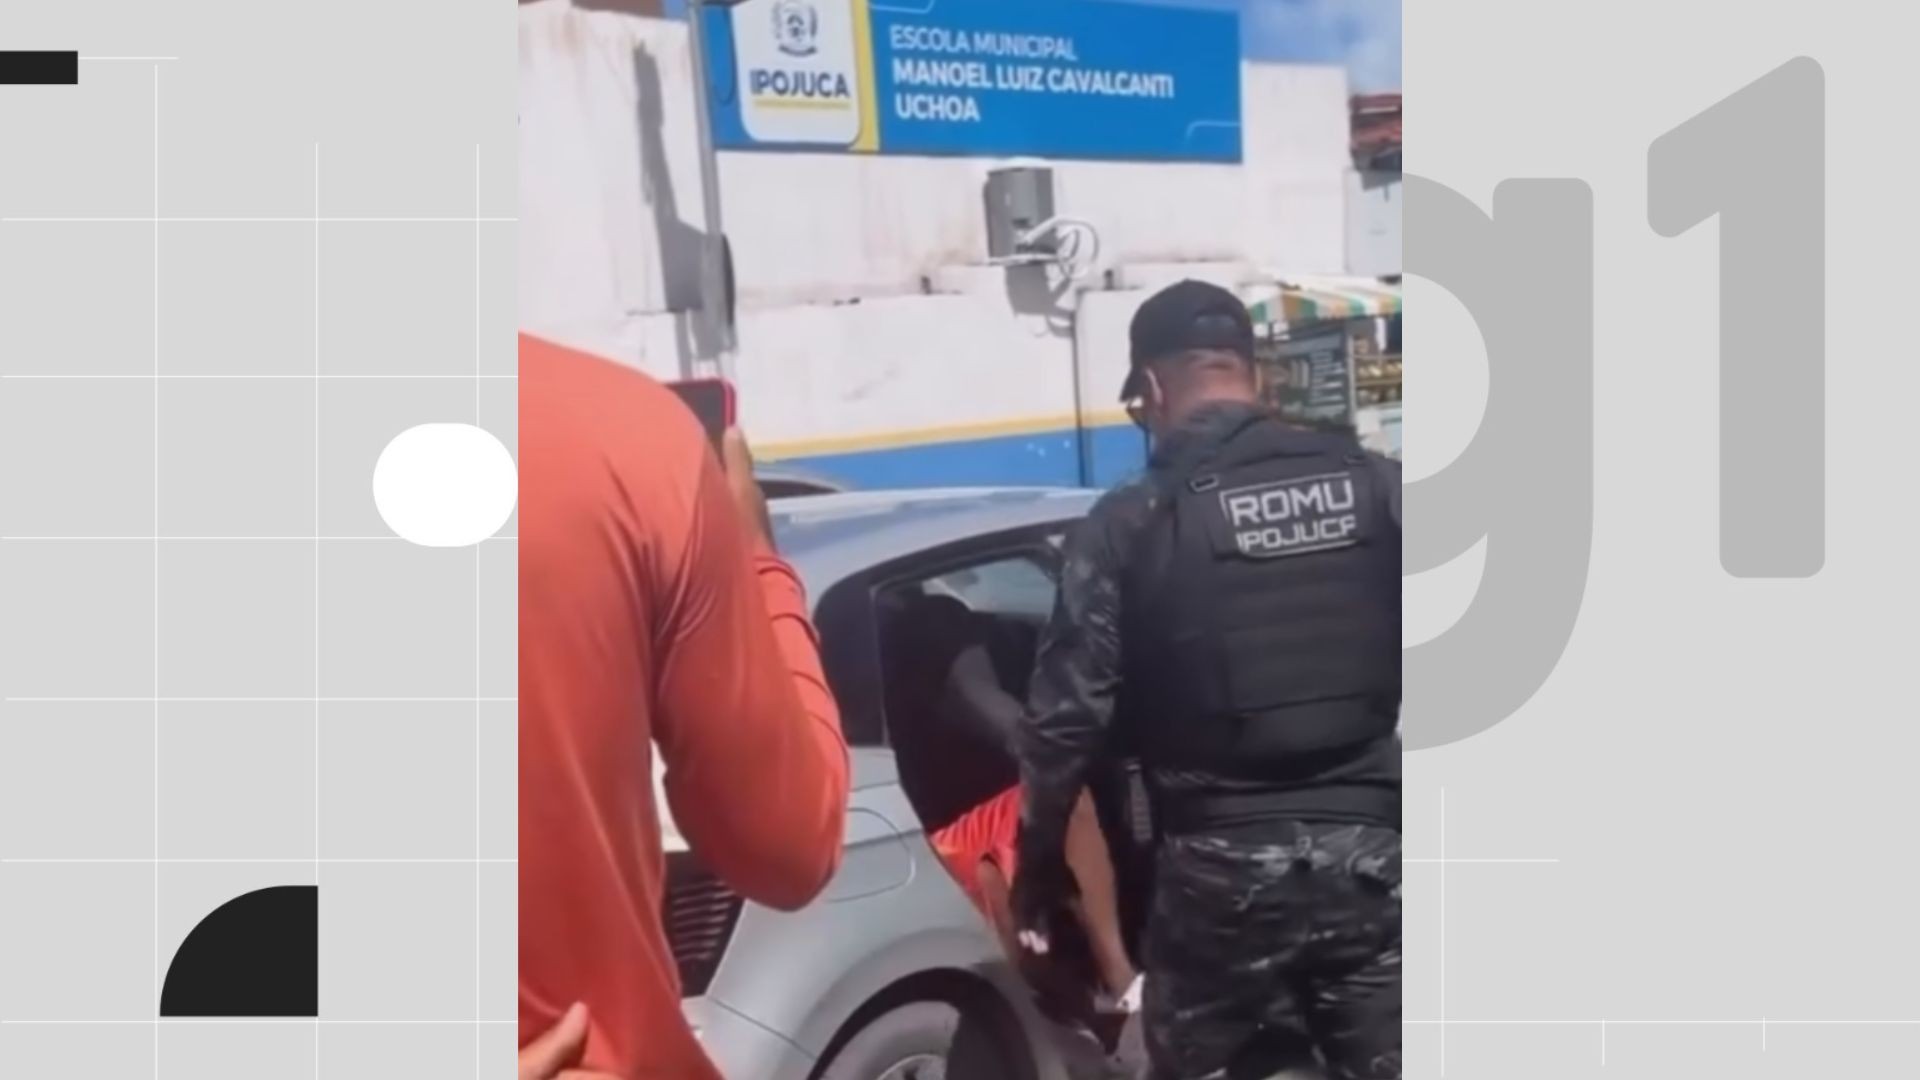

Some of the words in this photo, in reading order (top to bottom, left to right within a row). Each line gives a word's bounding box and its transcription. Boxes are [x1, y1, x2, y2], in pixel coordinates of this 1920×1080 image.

[890, 25, 969, 52] ESCOLA
[973, 30, 1077, 61] MUNICIPAL
[750, 69, 850, 98] IPOJUCA
[892, 58, 991, 88] MANOEL
[996, 65, 1043, 91] LUIZ
[1047, 68, 1174, 98] CAVALCANTI
[895, 95, 980, 122] UCHOA
[1229, 480, 1354, 527] ROMU
